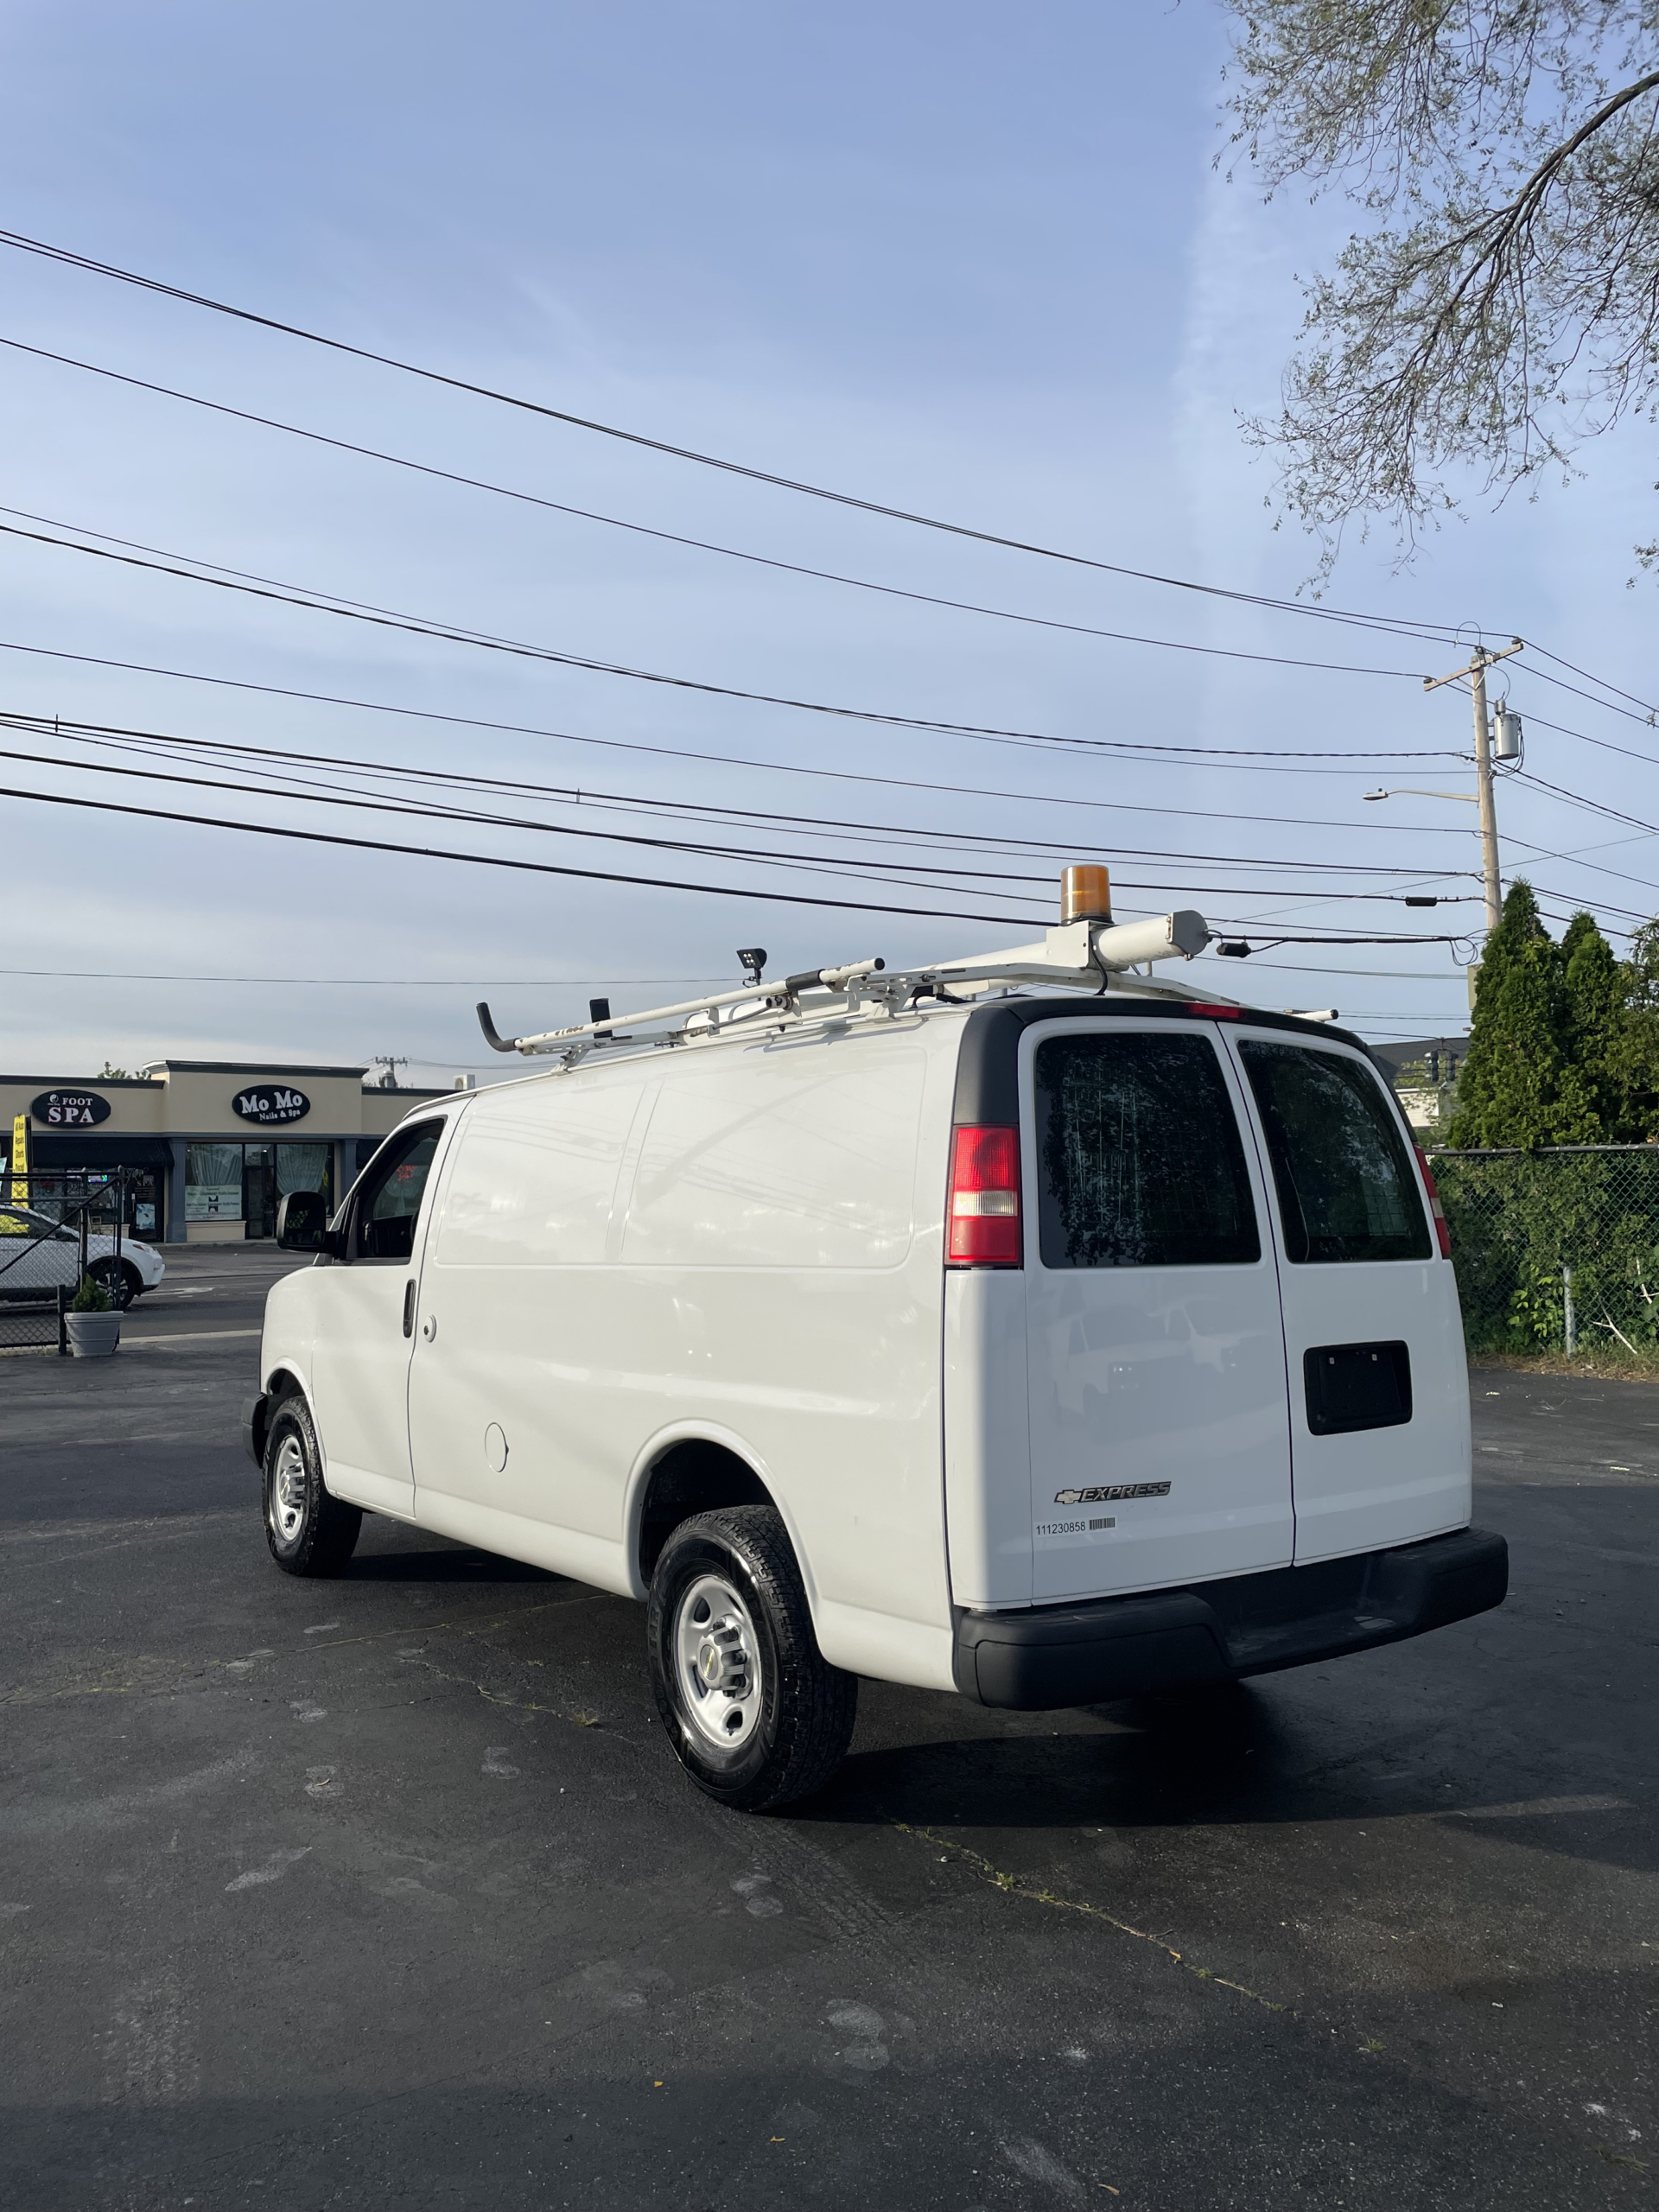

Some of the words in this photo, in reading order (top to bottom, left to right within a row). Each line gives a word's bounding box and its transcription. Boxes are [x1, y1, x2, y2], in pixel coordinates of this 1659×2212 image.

[62, 1097, 92, 1106] FOOT
[239, 1094, 270, 1114] Mo
[273, 1090, 302, 1109] Mo
[48, 1106, 94, 1123] SPA
[259, 1112, 278, 1121] Nails
[288, 1109, 301, 1117] Spa
[1080, 1482, 1171, 1503] EXPRESS
[1036, 1521, 1086, 1535] 111230858
